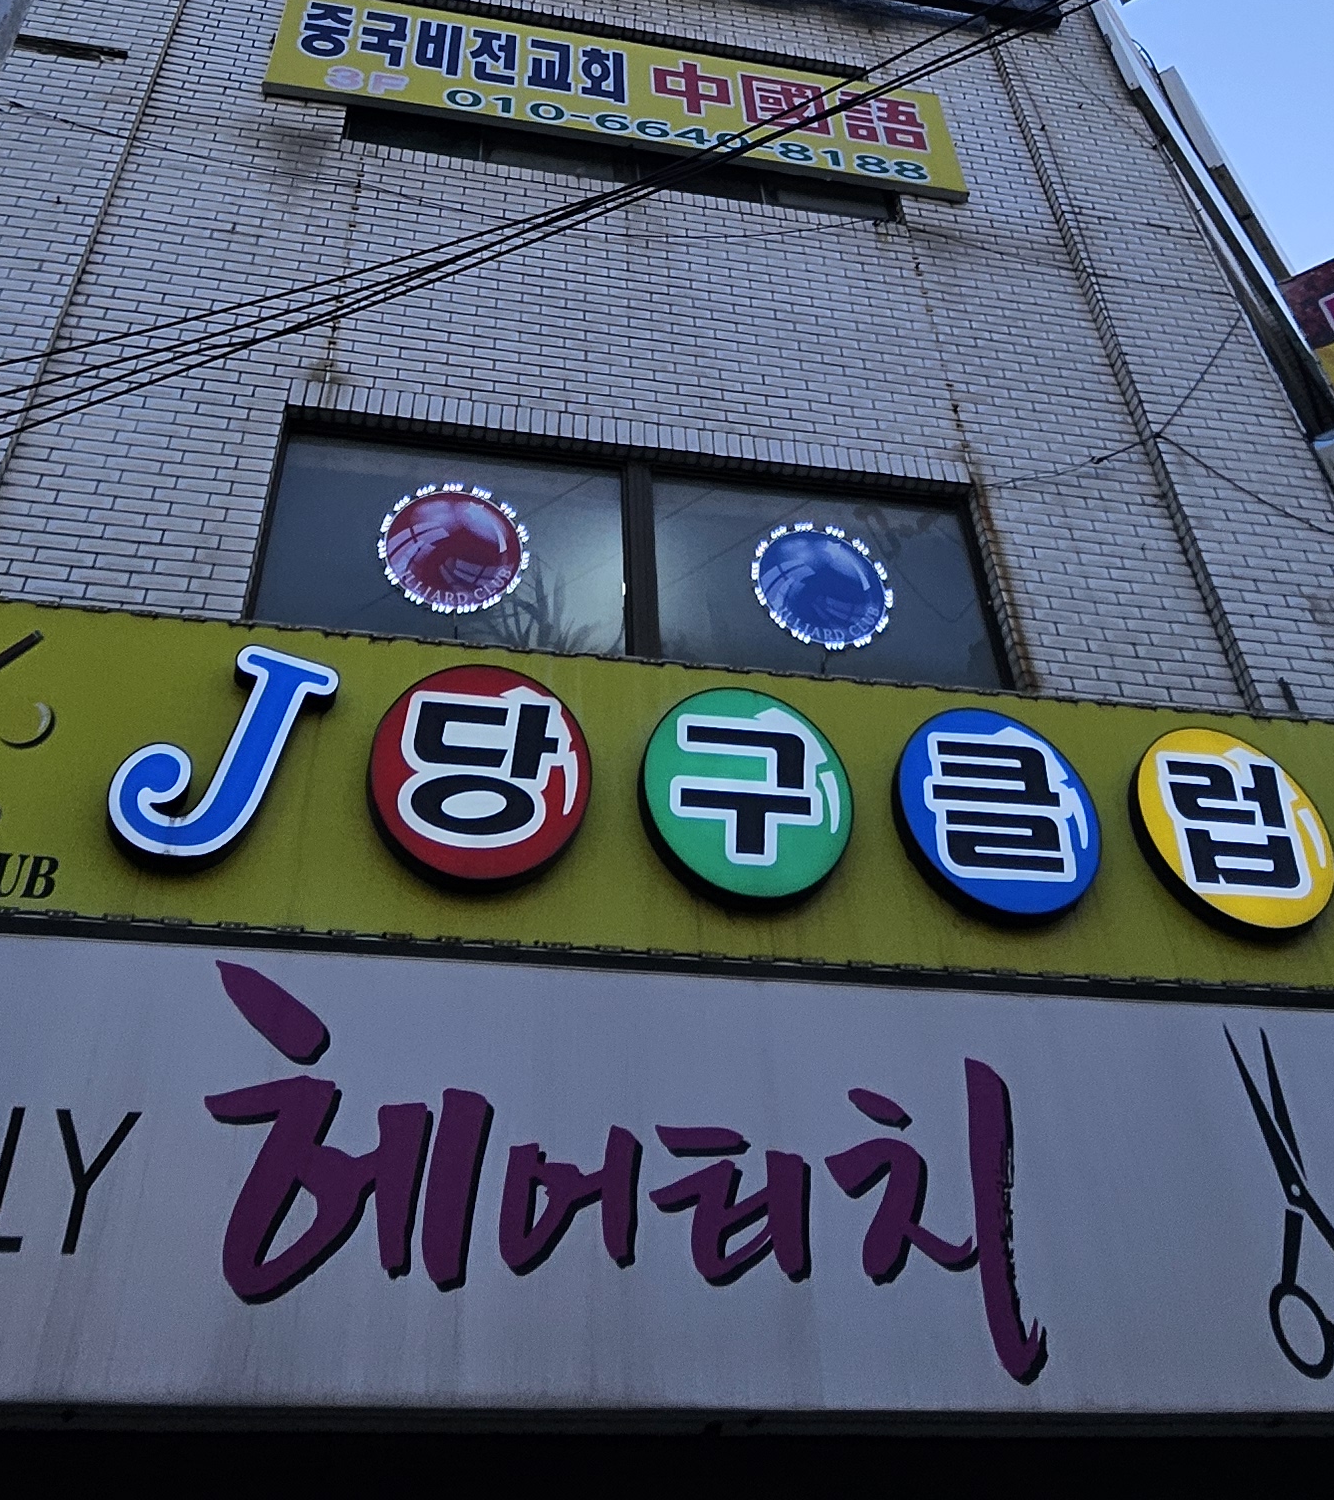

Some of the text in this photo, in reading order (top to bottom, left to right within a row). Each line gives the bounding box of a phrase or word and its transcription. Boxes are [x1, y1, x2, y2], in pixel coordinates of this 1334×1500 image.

[300, 1, 928, 151] 중국비전교회 中國語
[327, 66, 930, 181] 3F 010-6640-8188
[395, 566, 512, 604] ILLIARD CLUB
[775, 603, 880, 641] ILLIARD CLUB
[204, 959, 1050, 1387] 헤어터치
